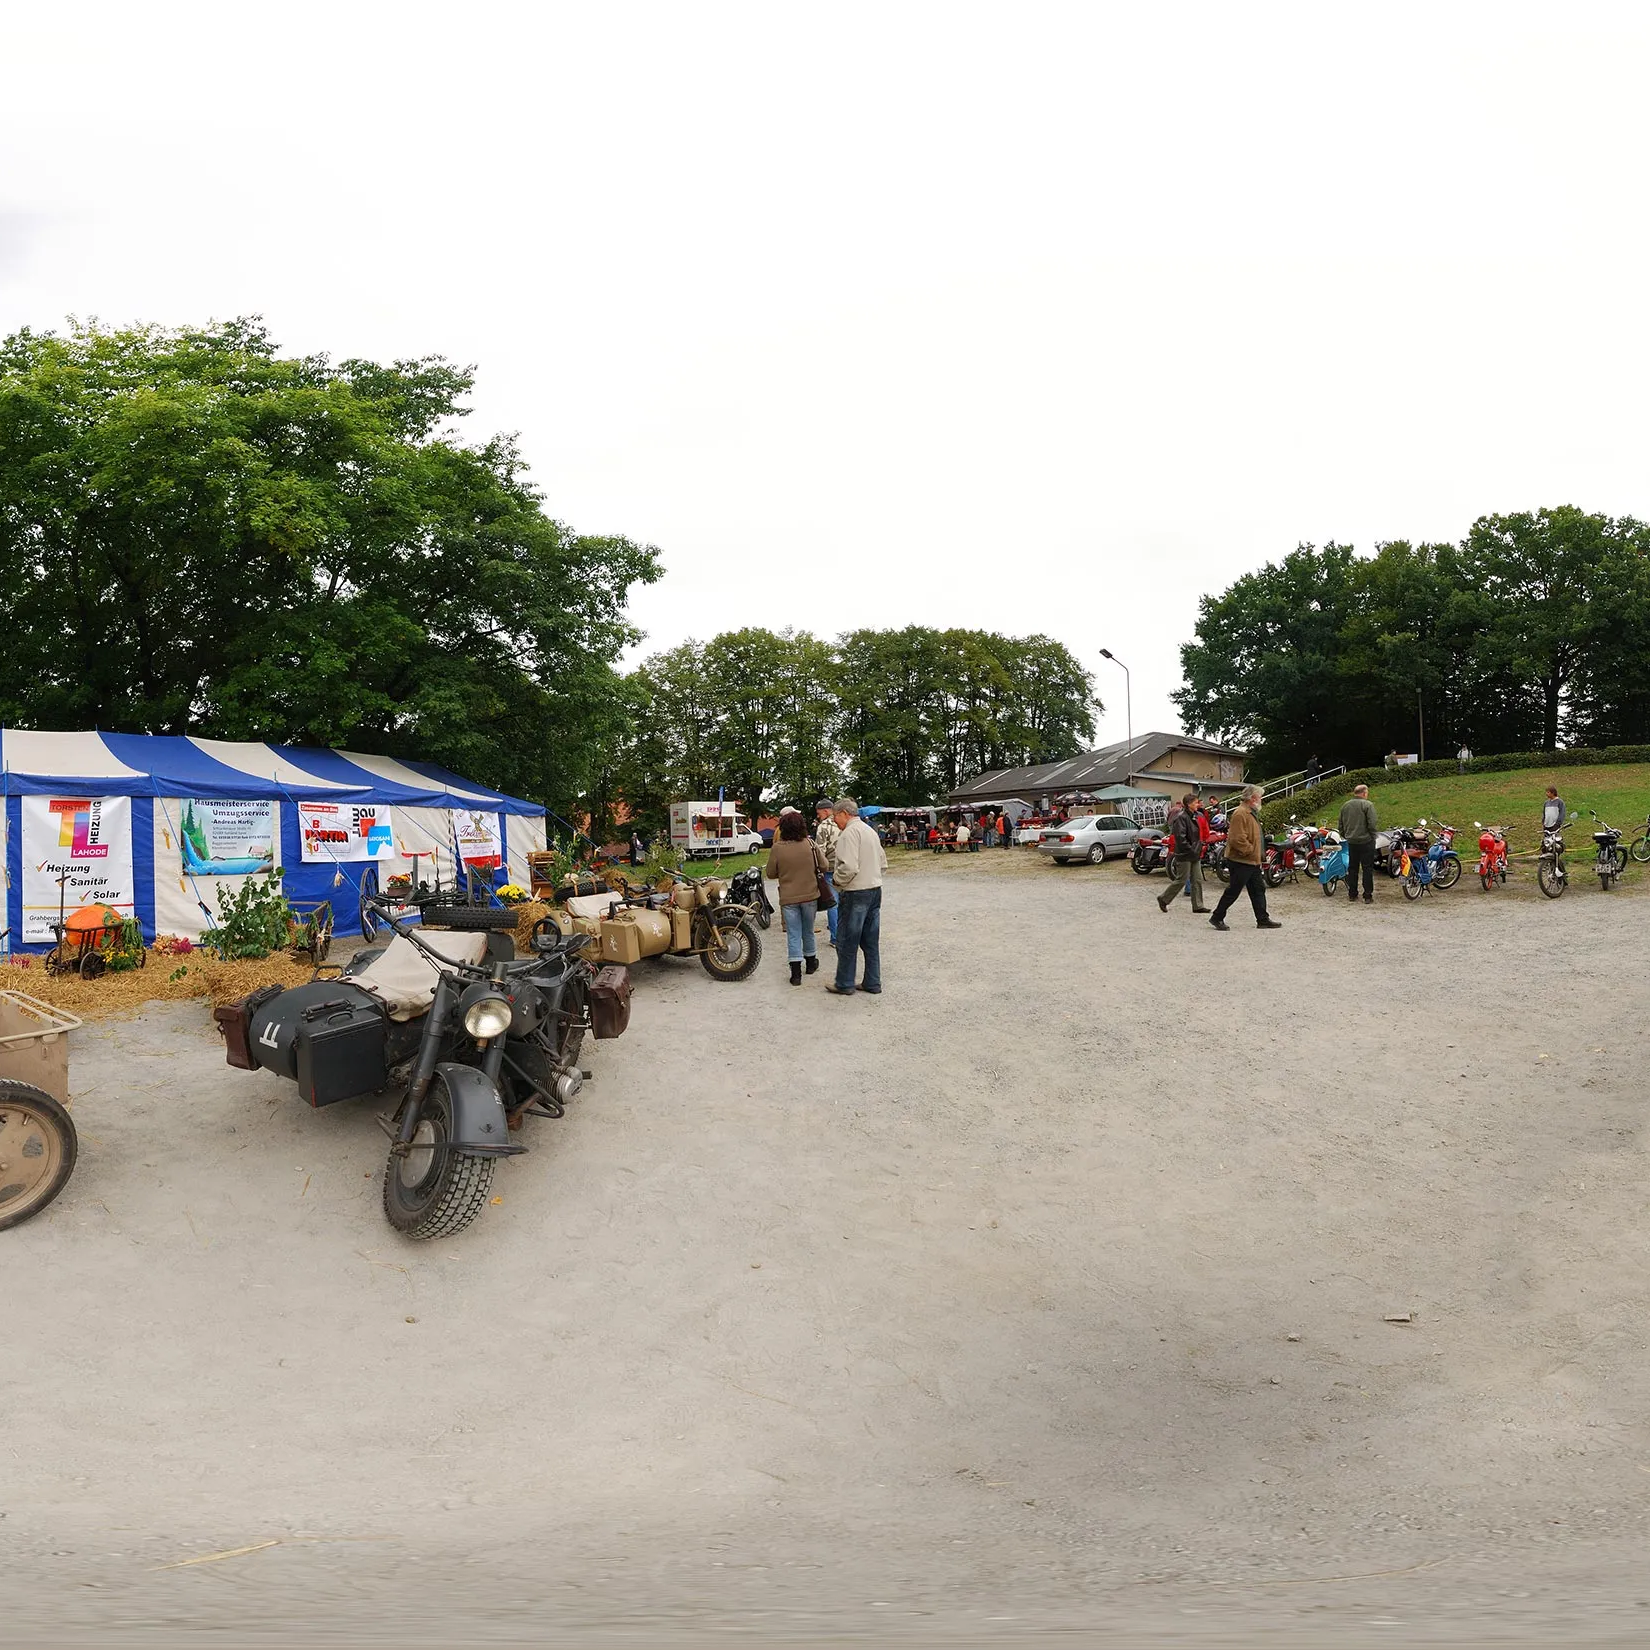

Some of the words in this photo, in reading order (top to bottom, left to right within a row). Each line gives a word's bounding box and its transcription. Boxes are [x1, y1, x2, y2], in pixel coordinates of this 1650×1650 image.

[194, 798, 270, 807] Hausmeisterservice
[212, 809, 270, 818] Umzugsservice
[90, 801, 102, 844] HEIZUNG
[305, 829, 349, 843] MARTIN
[73, 848, 107, 856] LAHODE
[47, 864, 91, 874] Heizung
[70, 877, 108, 886] Sanitär
[93, 890, 120, 899] Solar
